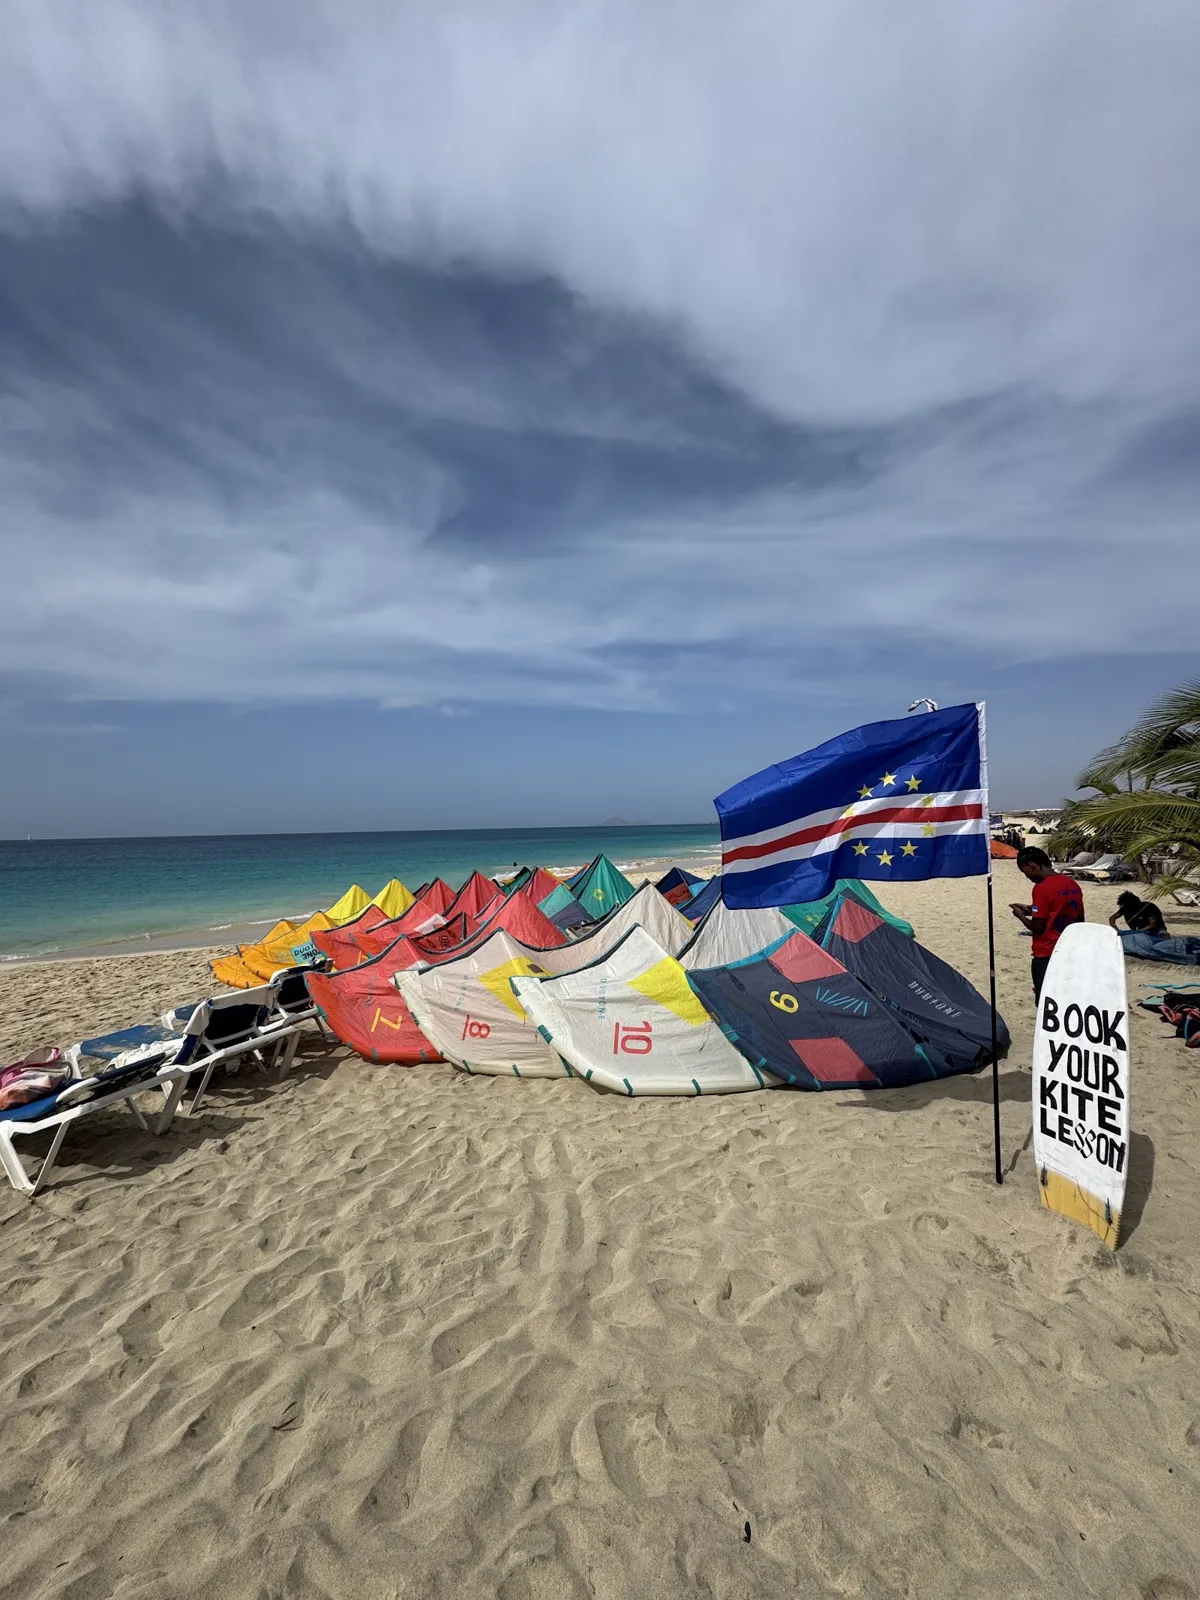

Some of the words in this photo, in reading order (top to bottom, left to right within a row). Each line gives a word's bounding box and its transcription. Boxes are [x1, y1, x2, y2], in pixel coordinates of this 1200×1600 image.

[468, 1020, 491, 1039] 8
[620, 1020, 653, 1055] 10
[1042, 996, 1127, 1051] BOOK
[1047, 1039, 1125, 1099] YOUR
[1040, 1076, 1121, 1136] KITE
[1040, 1106, 1127, 1173] LESSON
